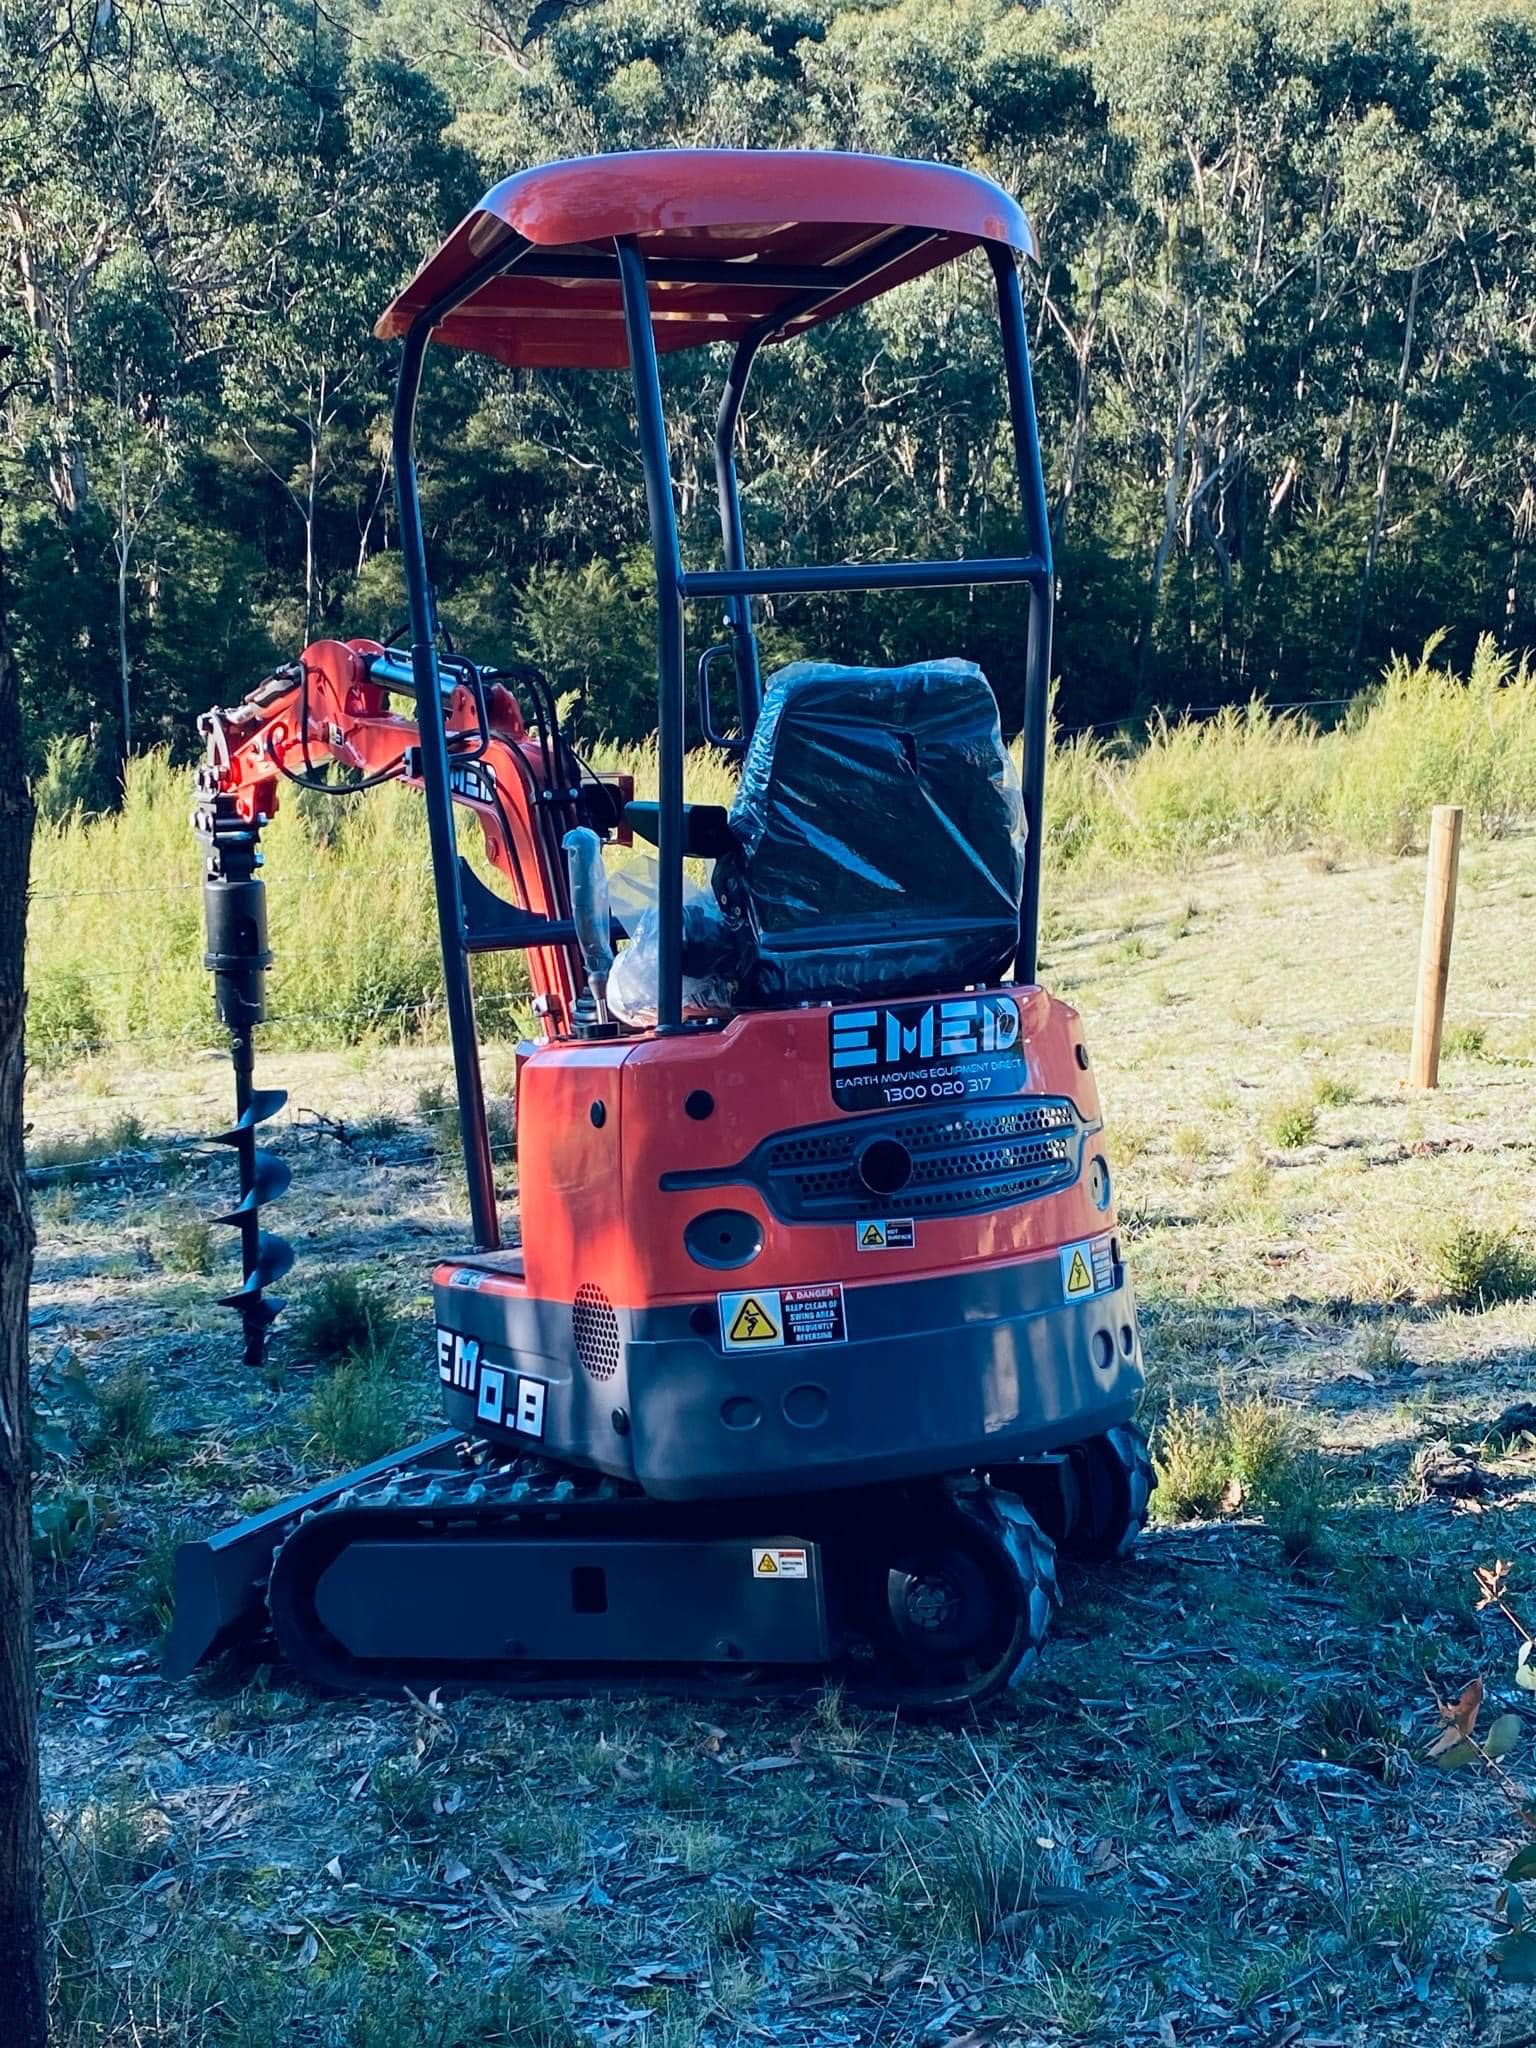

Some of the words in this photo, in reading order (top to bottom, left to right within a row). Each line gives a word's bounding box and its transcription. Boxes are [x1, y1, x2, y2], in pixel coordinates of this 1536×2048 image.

[833, 997, 1020, 1068] EMED
[836, 1075, 878, 1089] EARTH
[881, 1069, 928, 1083] MOVING
[930, 1062, 989, 1078] EQUIPMENT
[883, 1085, 927, 1102] 1300
[931, 1080, 965, 1096] 020
[967, 1077, 992, 1093] 317
[796, 1288, 834, 1300] DANGER
